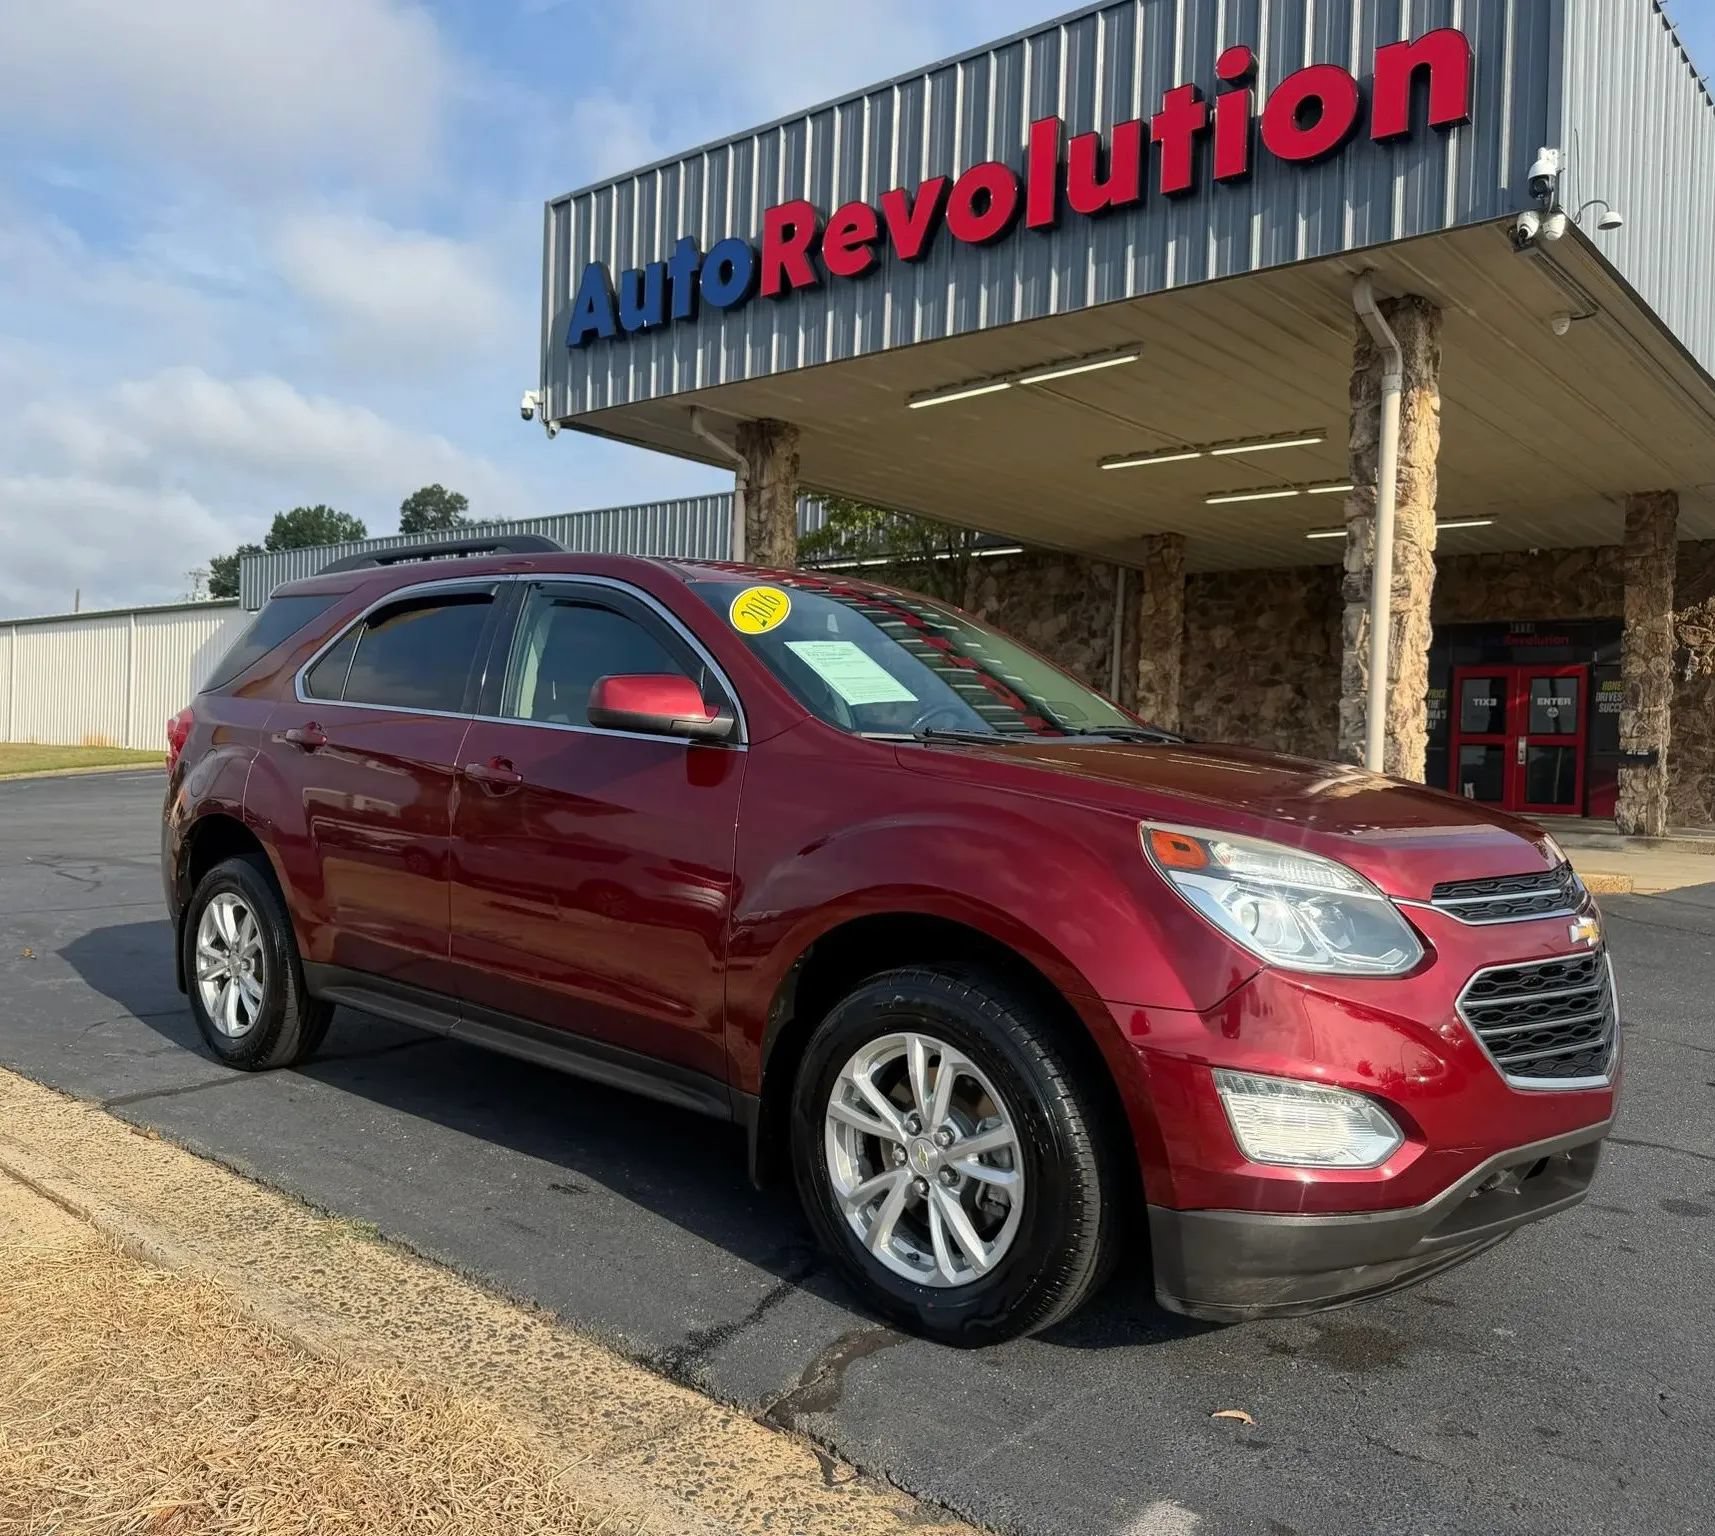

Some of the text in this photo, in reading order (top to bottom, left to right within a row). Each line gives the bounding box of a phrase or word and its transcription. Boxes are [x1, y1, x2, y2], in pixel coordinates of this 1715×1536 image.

[566, 27, 1473, 347] AutoRevolution
[741, 590, 781, 627] 2016
[1537, 697, 1571, 705] ENTER
